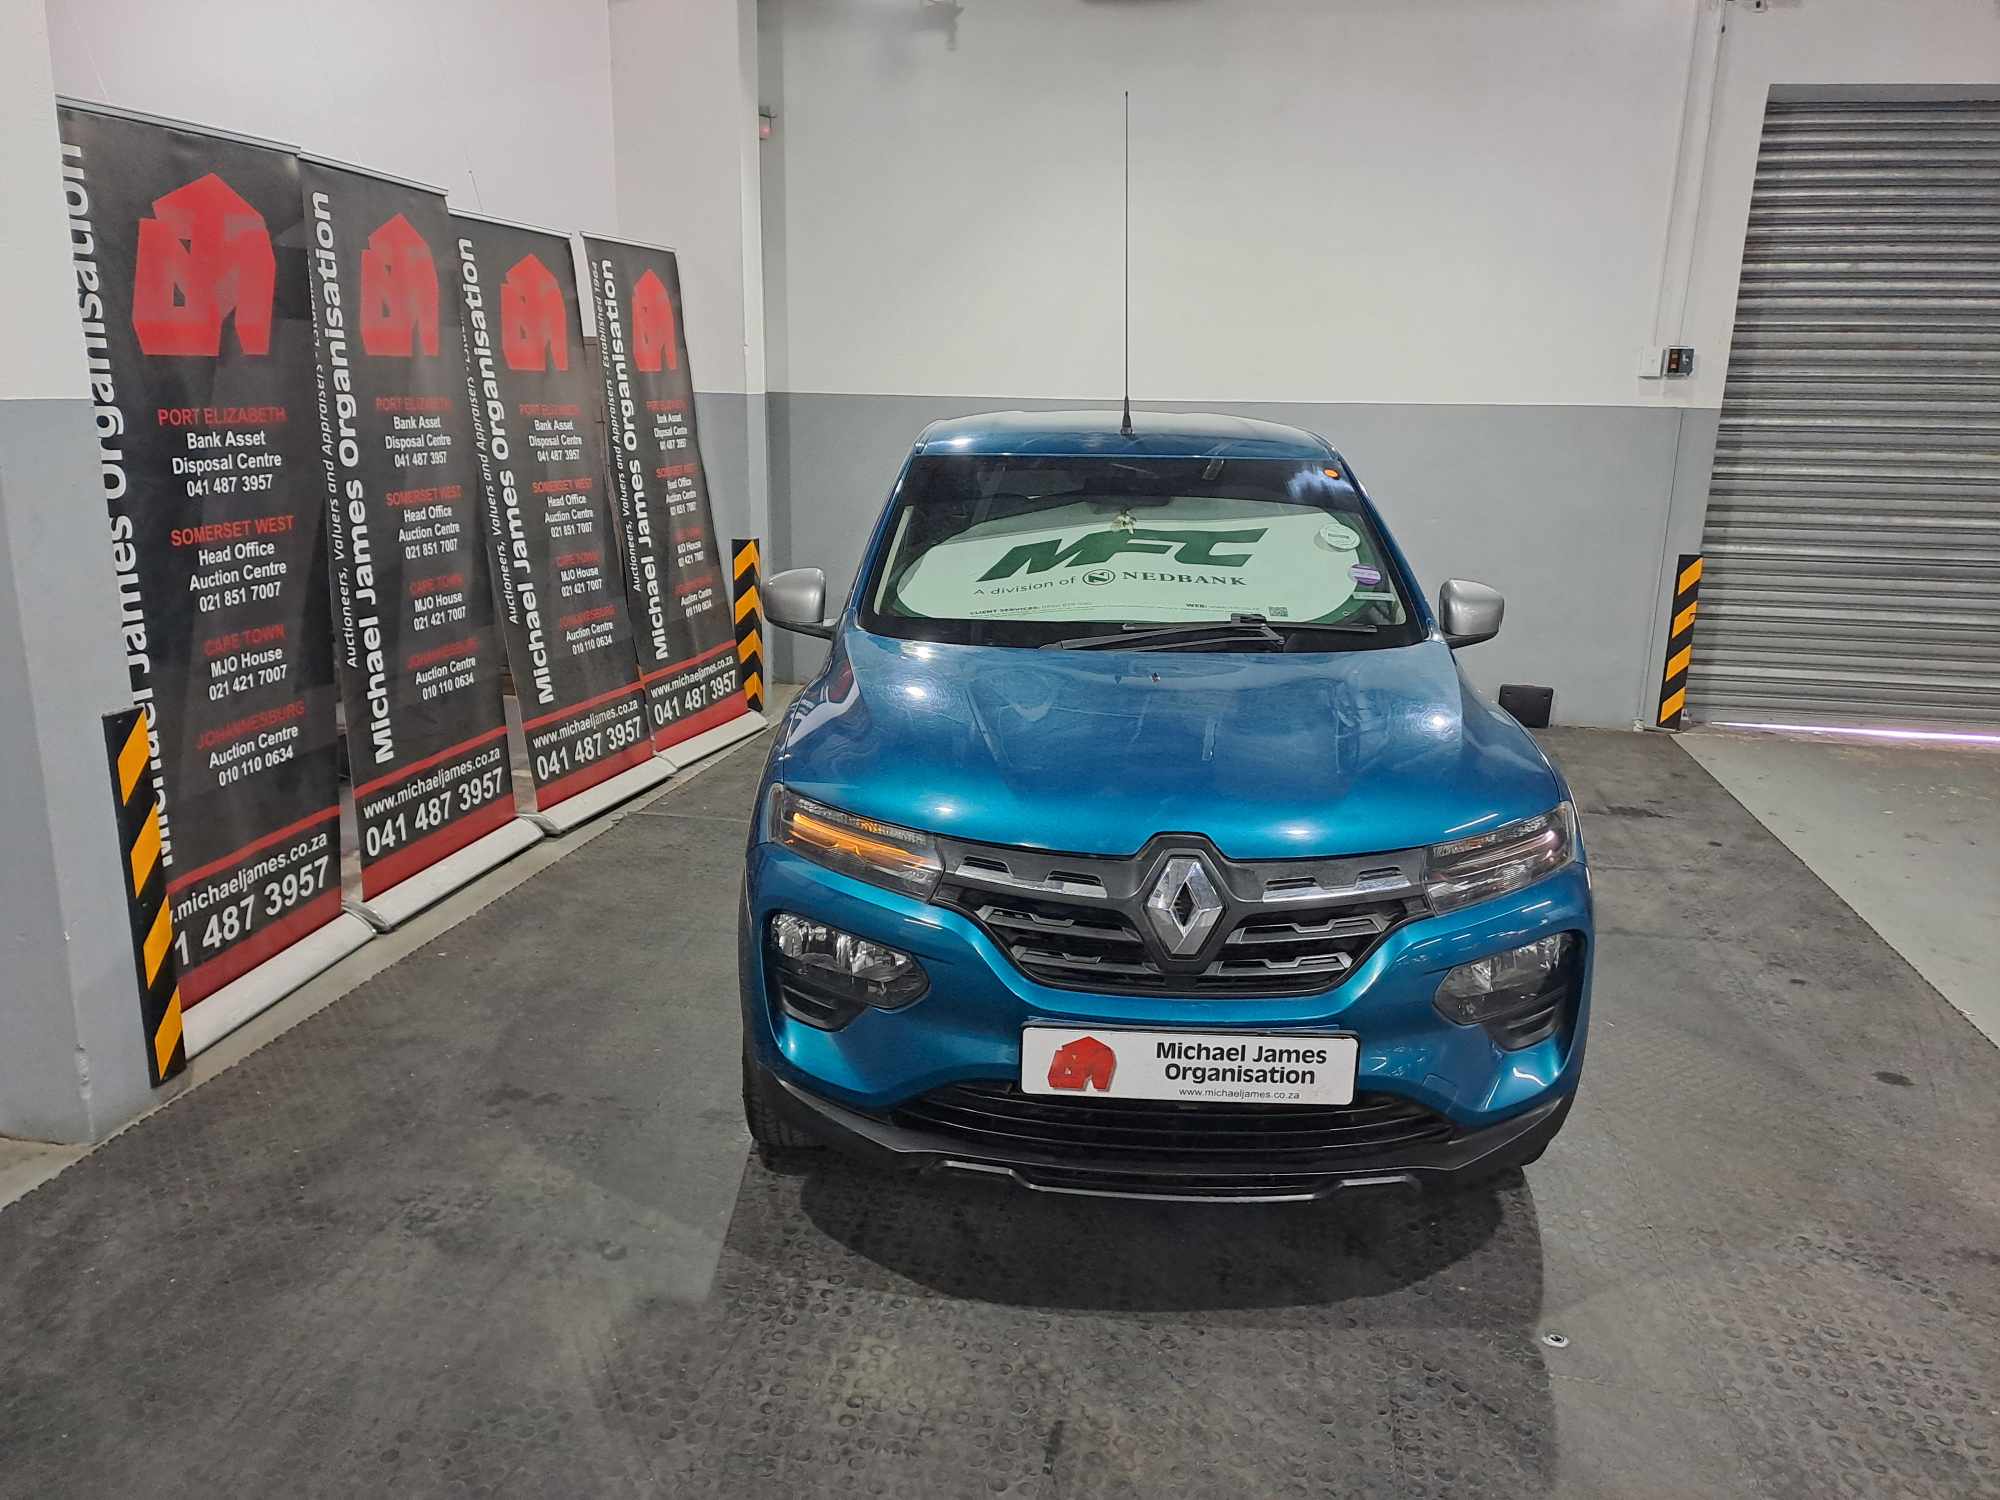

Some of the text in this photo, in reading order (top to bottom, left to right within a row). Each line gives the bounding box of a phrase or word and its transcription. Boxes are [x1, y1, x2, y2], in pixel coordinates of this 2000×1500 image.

[158, 407, 286, 426] PORT ELIZABETH
[393, 416, 441, 430] Bank Asset
[187, 430, 266, 450] Bank Asset
[385, 434, 452, 451] Disposal Centre
[172, 451, 282, 476] Disposal Centre
[394, 451, 447, 468] 041 487 3957
[459, 238, 554, 704] Michael James Organisation
[479, 453, 493, 481] and
[602, 260, 669, 660] Michael James Organisation
[187, 474, 273, 497] 041 487 3957
[313, 191, 394, 764] Michael James Organisation
[324, 458, 338, 493] and
[404, 505, 452, 522] Head Office
[486, 486, 502, 536] Valuers
[171, 516, 295, 546] SOMERSET WEST
[329, 497, 346, 560] Valuers
[398, 522, 460, 542] Auction Centre
[199, 542, 275, 566] Head Office
[405, 538, 458, 560] 021 851 7007
[975, 528, 1269, 583] MFC
[190, 562, 287, 591] Auction Centre
[991, 581, 1053, 595] division
[1058, 576, 1075, 585] of
[1121, 571, 1248, 586] NEDBANK
[200, 582, 281, 613] 021 851 7007
[414, 592, 462, 612] MJO House
[338, 566, 358, 668] Auctioneers,
[413, 606, 466, 631] 021 421 7007
[211, 648, 283, 678] MJO House
[415, 666, 447, 684] Auction
[209, 664, 288, 701] 021 421 7007
[422, 672, 474, 700] 010 110 0634
[654, 670, 736, 725] 041 487 3957
[532, 700, 638, 749] www.michaeljames.co.za
[210, 726, 299, 769] Auction Centre
[537, 716, 641, 780] 041 487 3957
[219, 744, 295, 787] 010 110 0634
[363, 747, 501, 819] www.michaeljames.co.za
[366, 767, 503, 857] 041 487 3957
[170, 832, 328, 924] .michaeljames.co.za
[202, 894, 256, 949] 487
[264, 855, 329, 916] 3957
[1156, 1042, 1328, 1064] Michael James
[1164, 1063, 1316, 1085] Organisation
[1178, 1087, 1300, 1100] www.michaeljames.co.za
